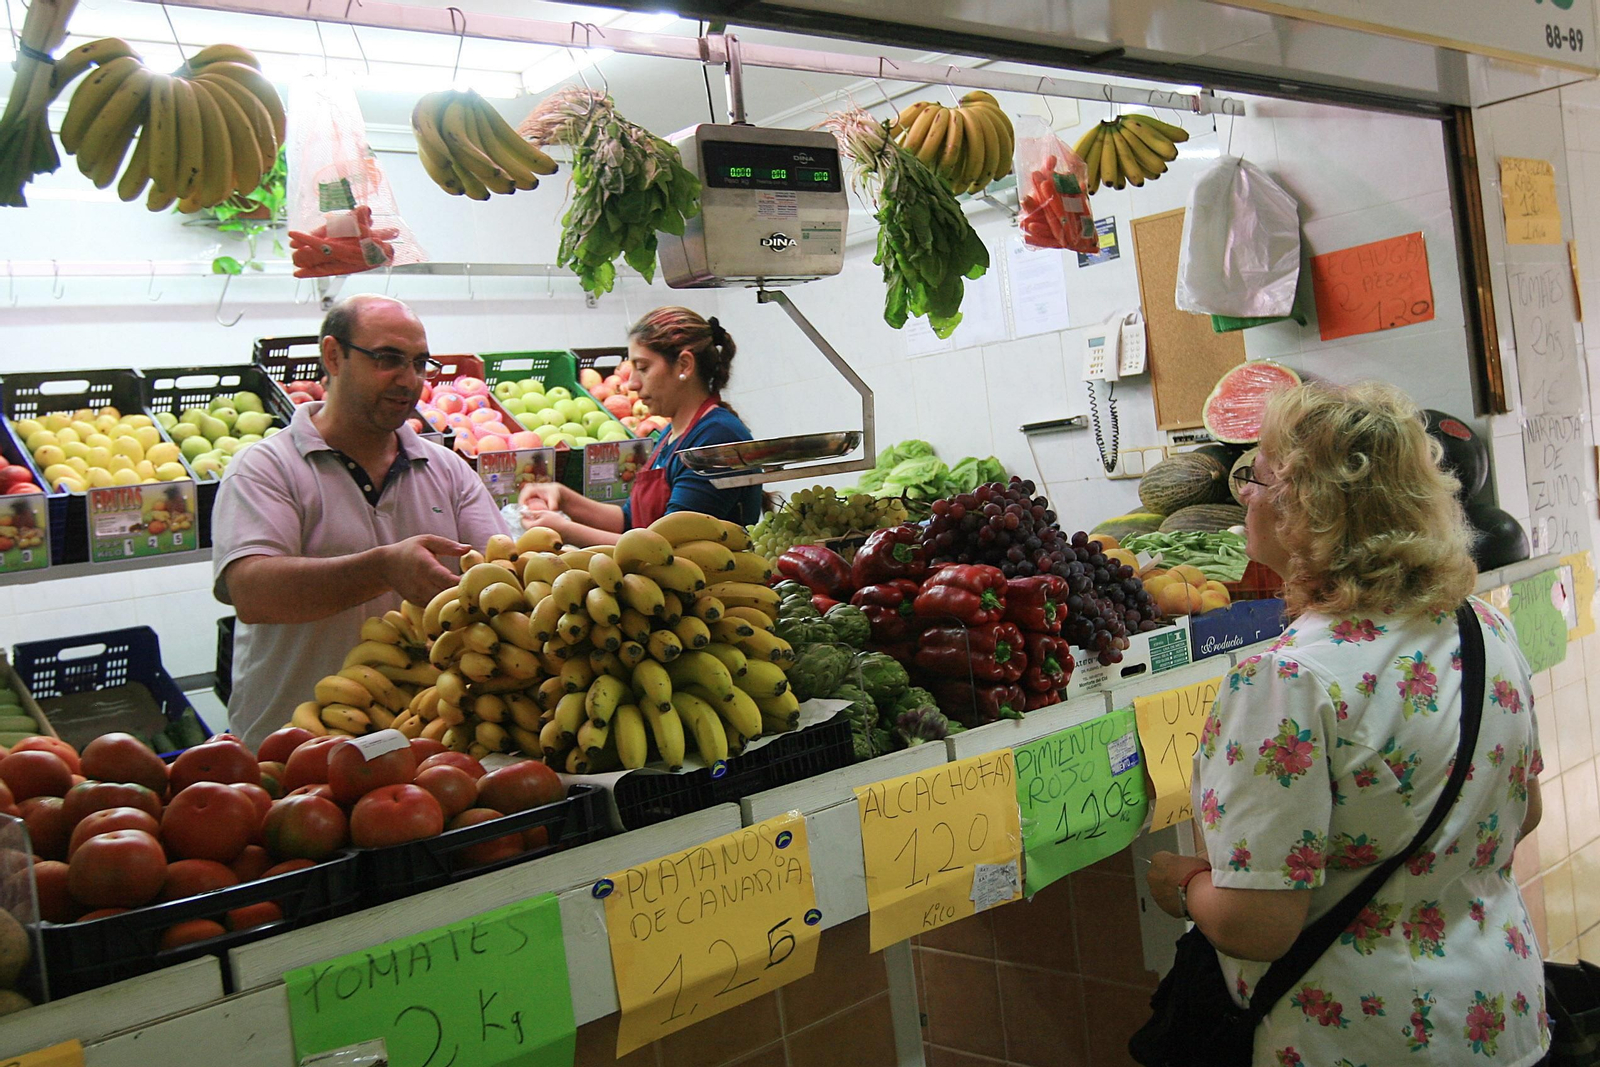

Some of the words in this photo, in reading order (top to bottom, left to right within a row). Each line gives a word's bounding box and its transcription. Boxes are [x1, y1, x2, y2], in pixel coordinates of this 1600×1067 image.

[1545, 24, 1583, 52] 88-89
[793, 153, 815, 163] DINA
[761, 237, 797, 247] DINA
[1526, 414, 1580, 444] NARANJA
[1543, 443, 1562, 470] DE
[1532, 473, 1580, 511] ZUMO
[1200, 632, 1244, 654] Productos
[864, 753, 1012, 823] ALCACHOFAS
[1029, 761, 1095, 809] ROJO
[626, 824, 774, 909] PLATANOS
[894, 813, 989, 889] 1,20
[630, 908, 667, 941] DE
[304, 907, 528, 1013] TOMATES
[653, 917, 796, 1025] 1,25
[394, 1005, 458, 1067] 2
[479, 989, 525, 1045] Kg
